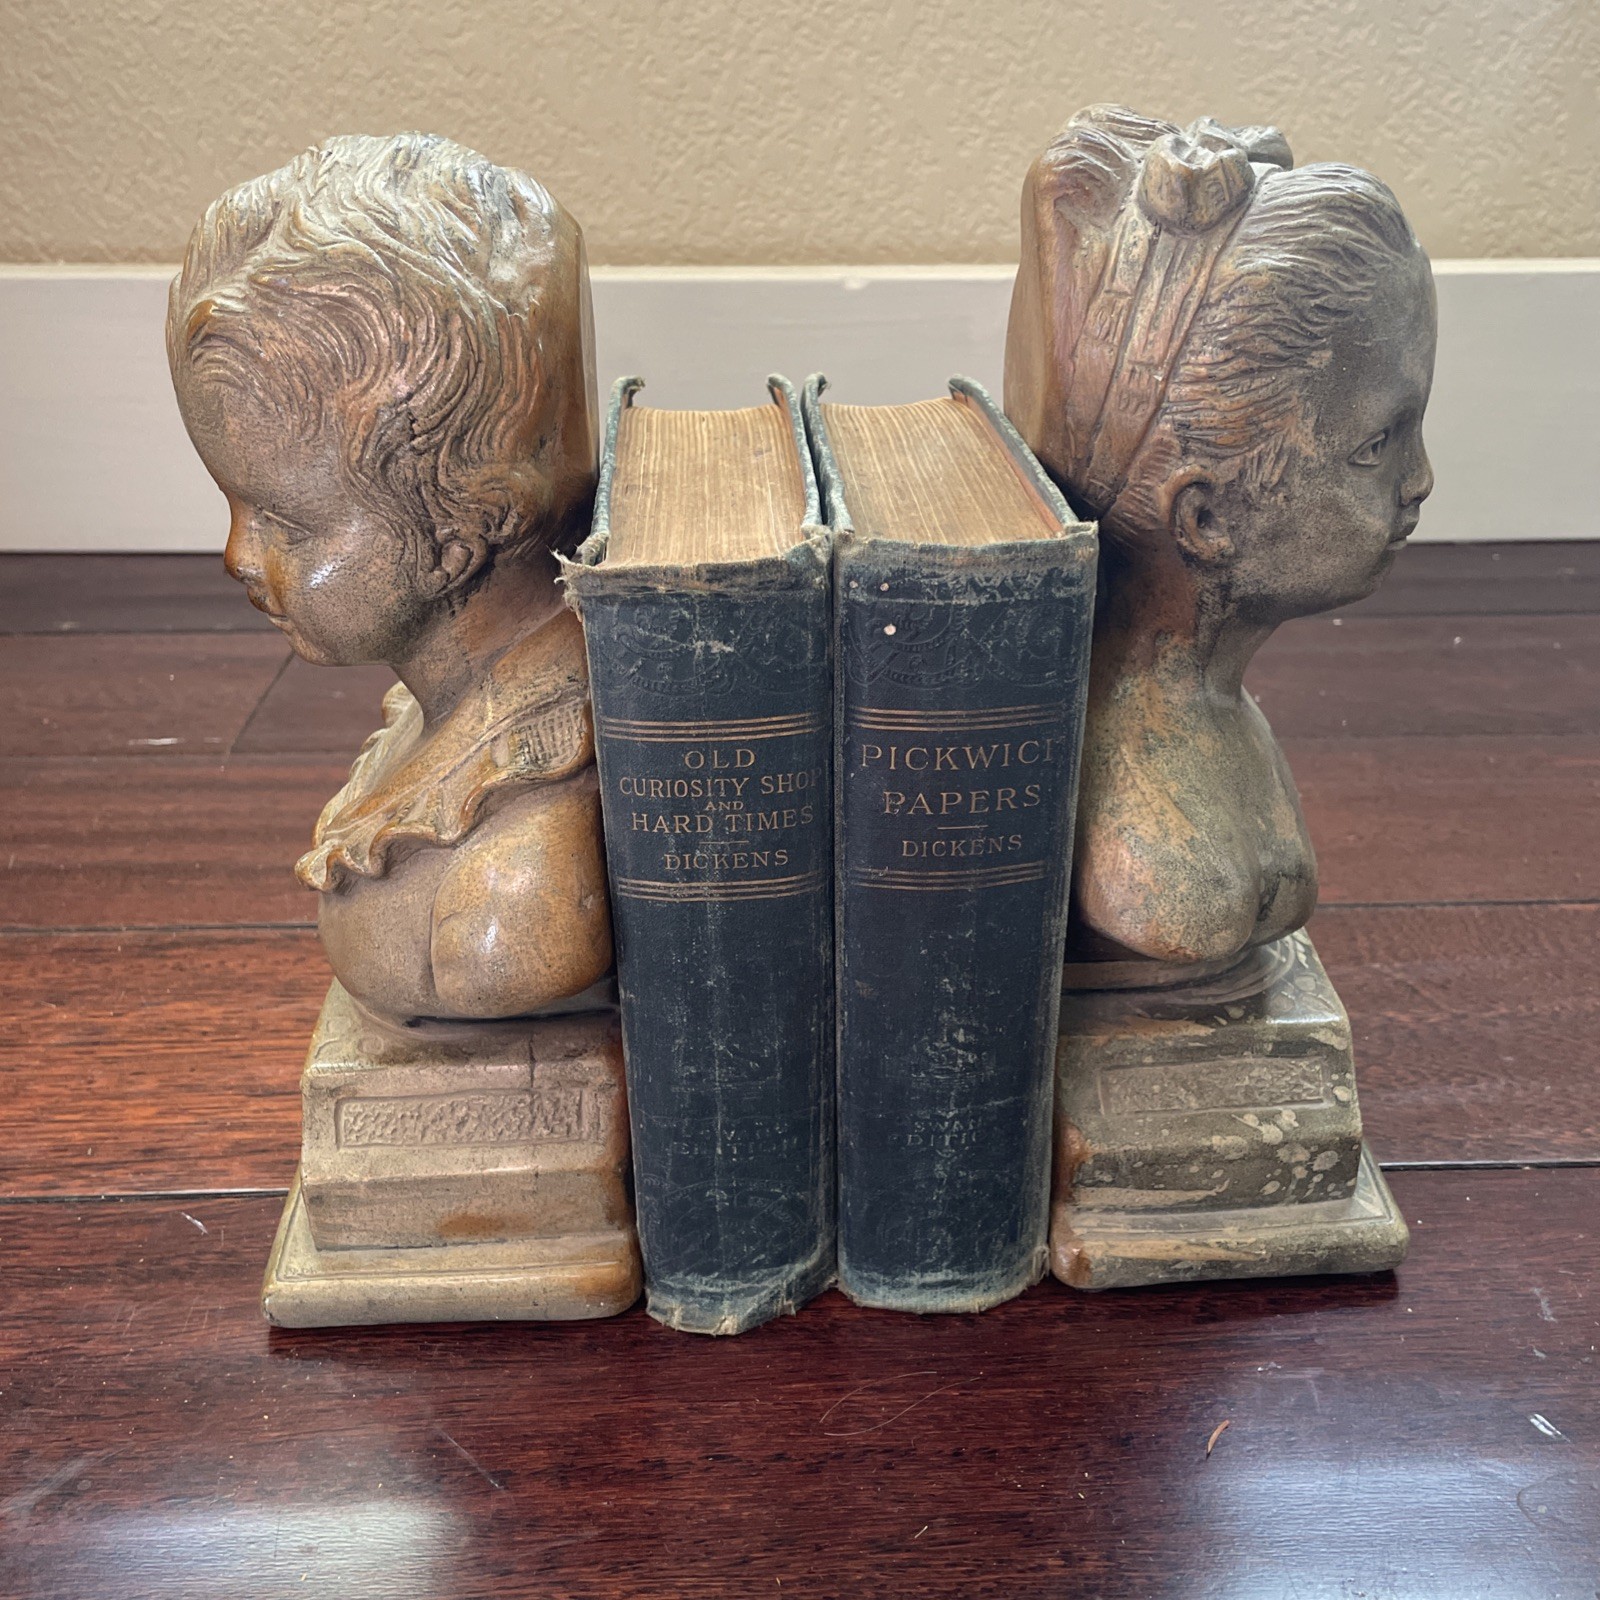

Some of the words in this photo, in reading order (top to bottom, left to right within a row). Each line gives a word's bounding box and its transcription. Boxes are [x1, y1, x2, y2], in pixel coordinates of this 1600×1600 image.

[684, 748, 756, 770] OLD
[619, 777, 750, 798] CURIOSITY
[704, 800, 745, 811] AND
[882, 784, 1042, 815] PAPERS
[631, 812, 714, 834] HARD
[725, 805, 814, 833] TIMES
[902, 834, 1023, 858] DICKENS
[664, 849, 790, 870] DICKENS
